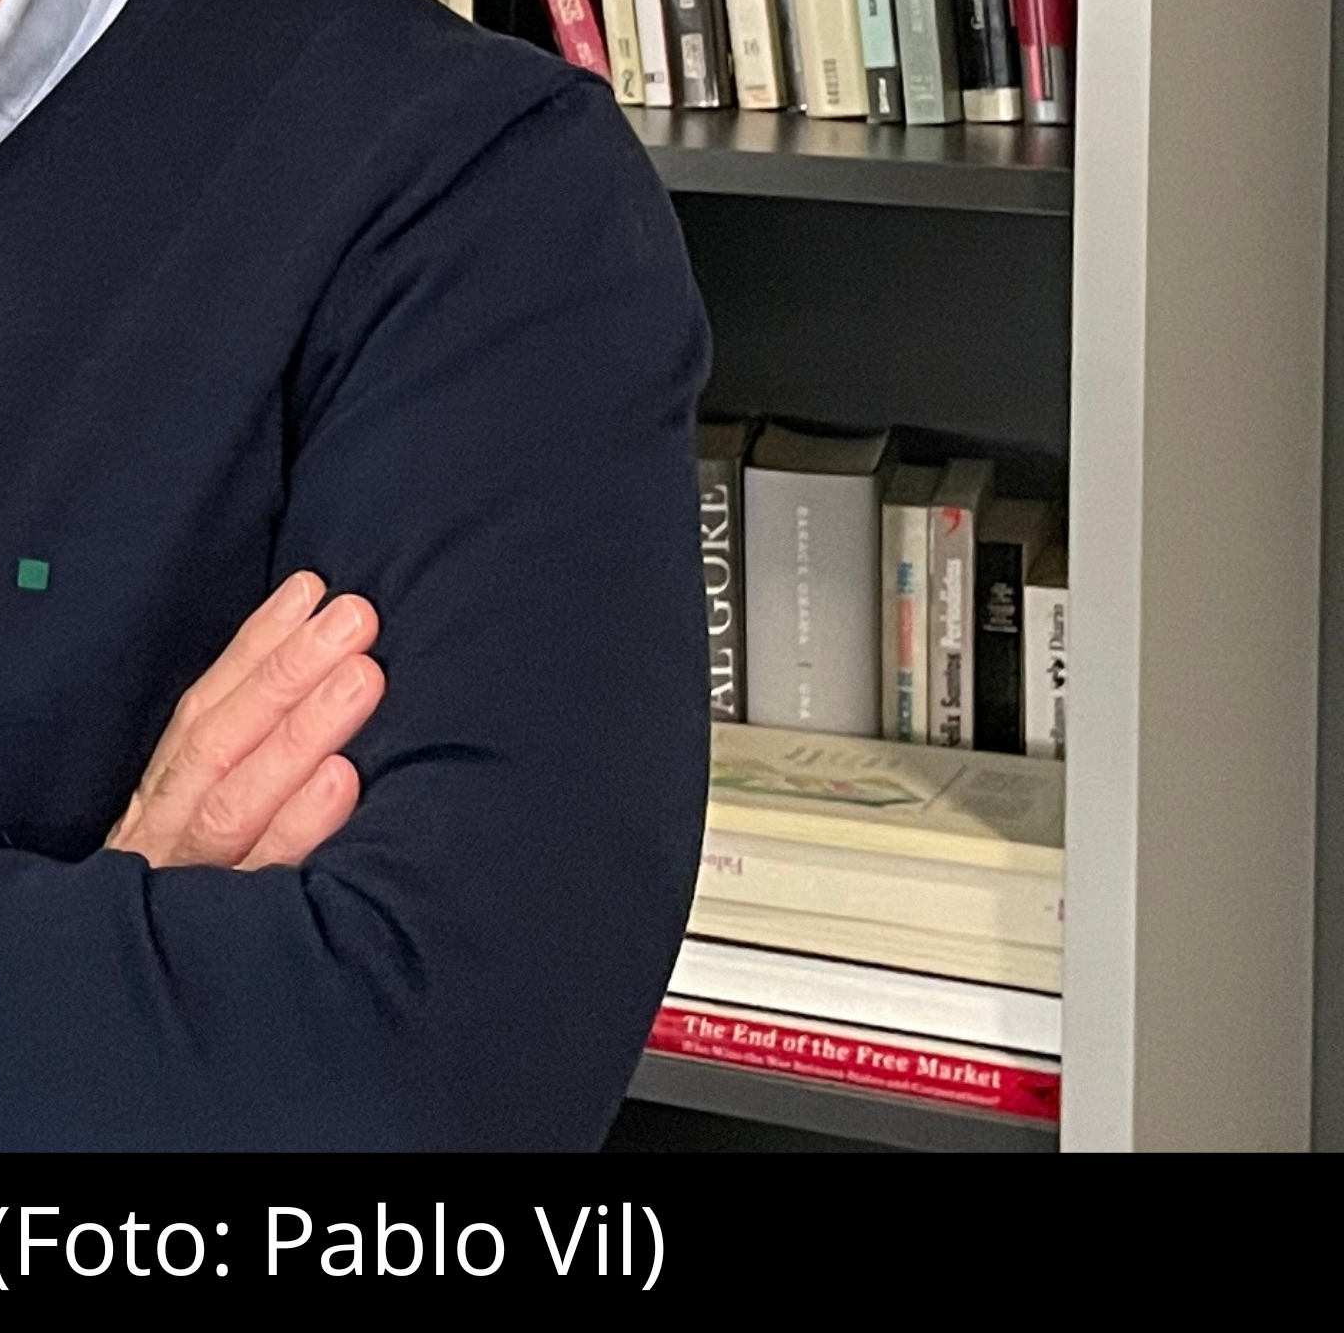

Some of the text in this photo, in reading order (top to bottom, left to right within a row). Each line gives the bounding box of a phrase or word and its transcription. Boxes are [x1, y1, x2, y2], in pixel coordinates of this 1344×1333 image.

[700, 483, 734, 715] AL GORE
[681, 1013, 1002, 1089] The End of the Free Market
